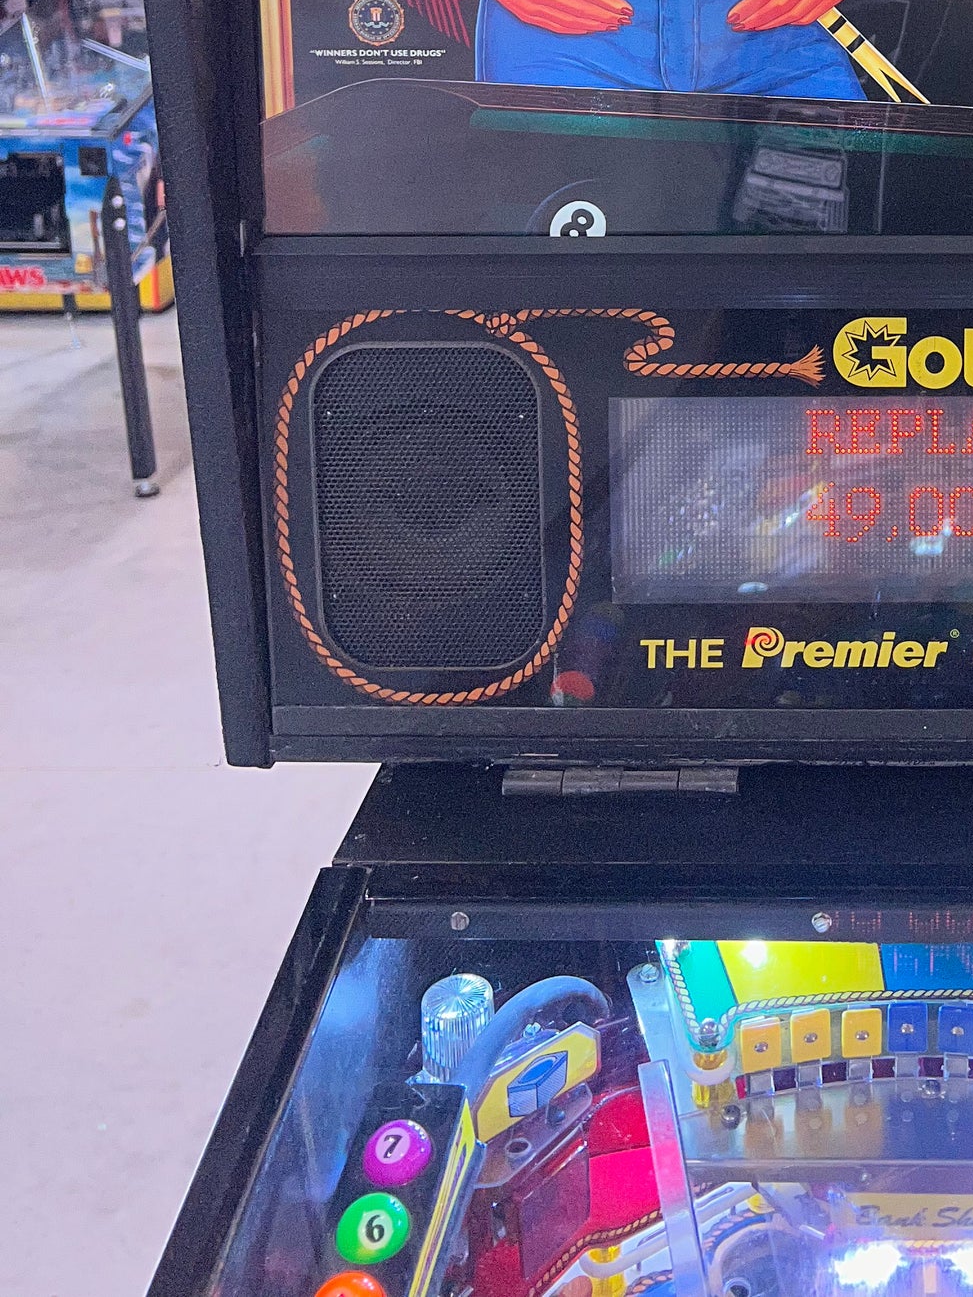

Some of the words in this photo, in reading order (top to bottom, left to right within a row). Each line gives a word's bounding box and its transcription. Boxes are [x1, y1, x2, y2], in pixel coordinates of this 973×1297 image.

[359, 49, 388, 57] DON'T
[390, 49, 408, 57] USE
[560, 208, 594, 237] 8
[640, 638, 725, 669] THE
[383, 1134, 403, 1159] 7
[365, 1214, 385, 1243] 6
